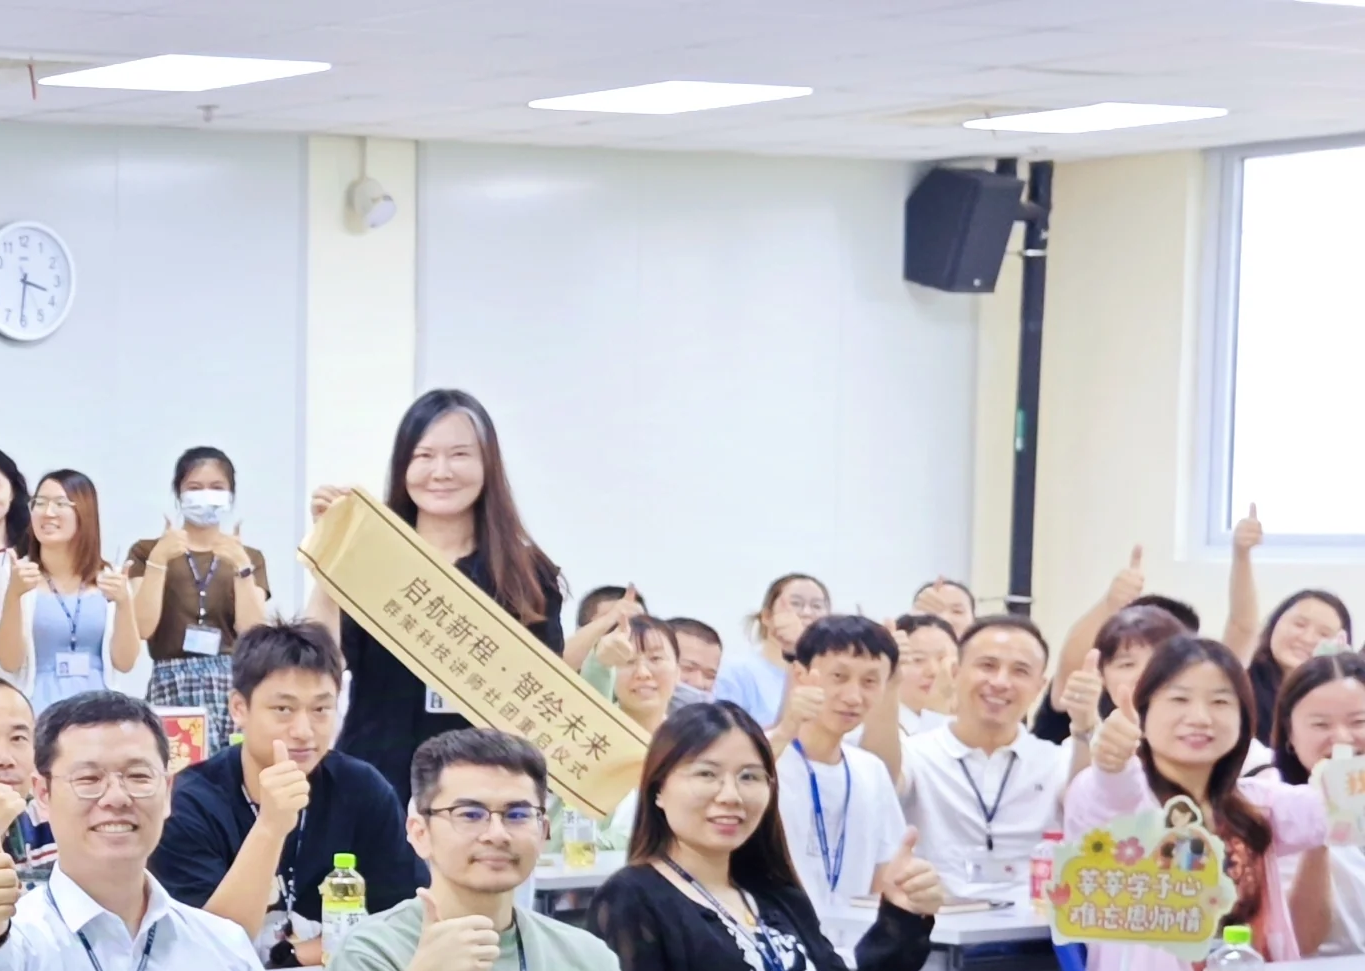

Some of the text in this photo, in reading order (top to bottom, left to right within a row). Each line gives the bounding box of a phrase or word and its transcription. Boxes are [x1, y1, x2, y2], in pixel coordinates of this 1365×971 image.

[382, 598, 589, 781] 群策科技讲师社团重启仪式
